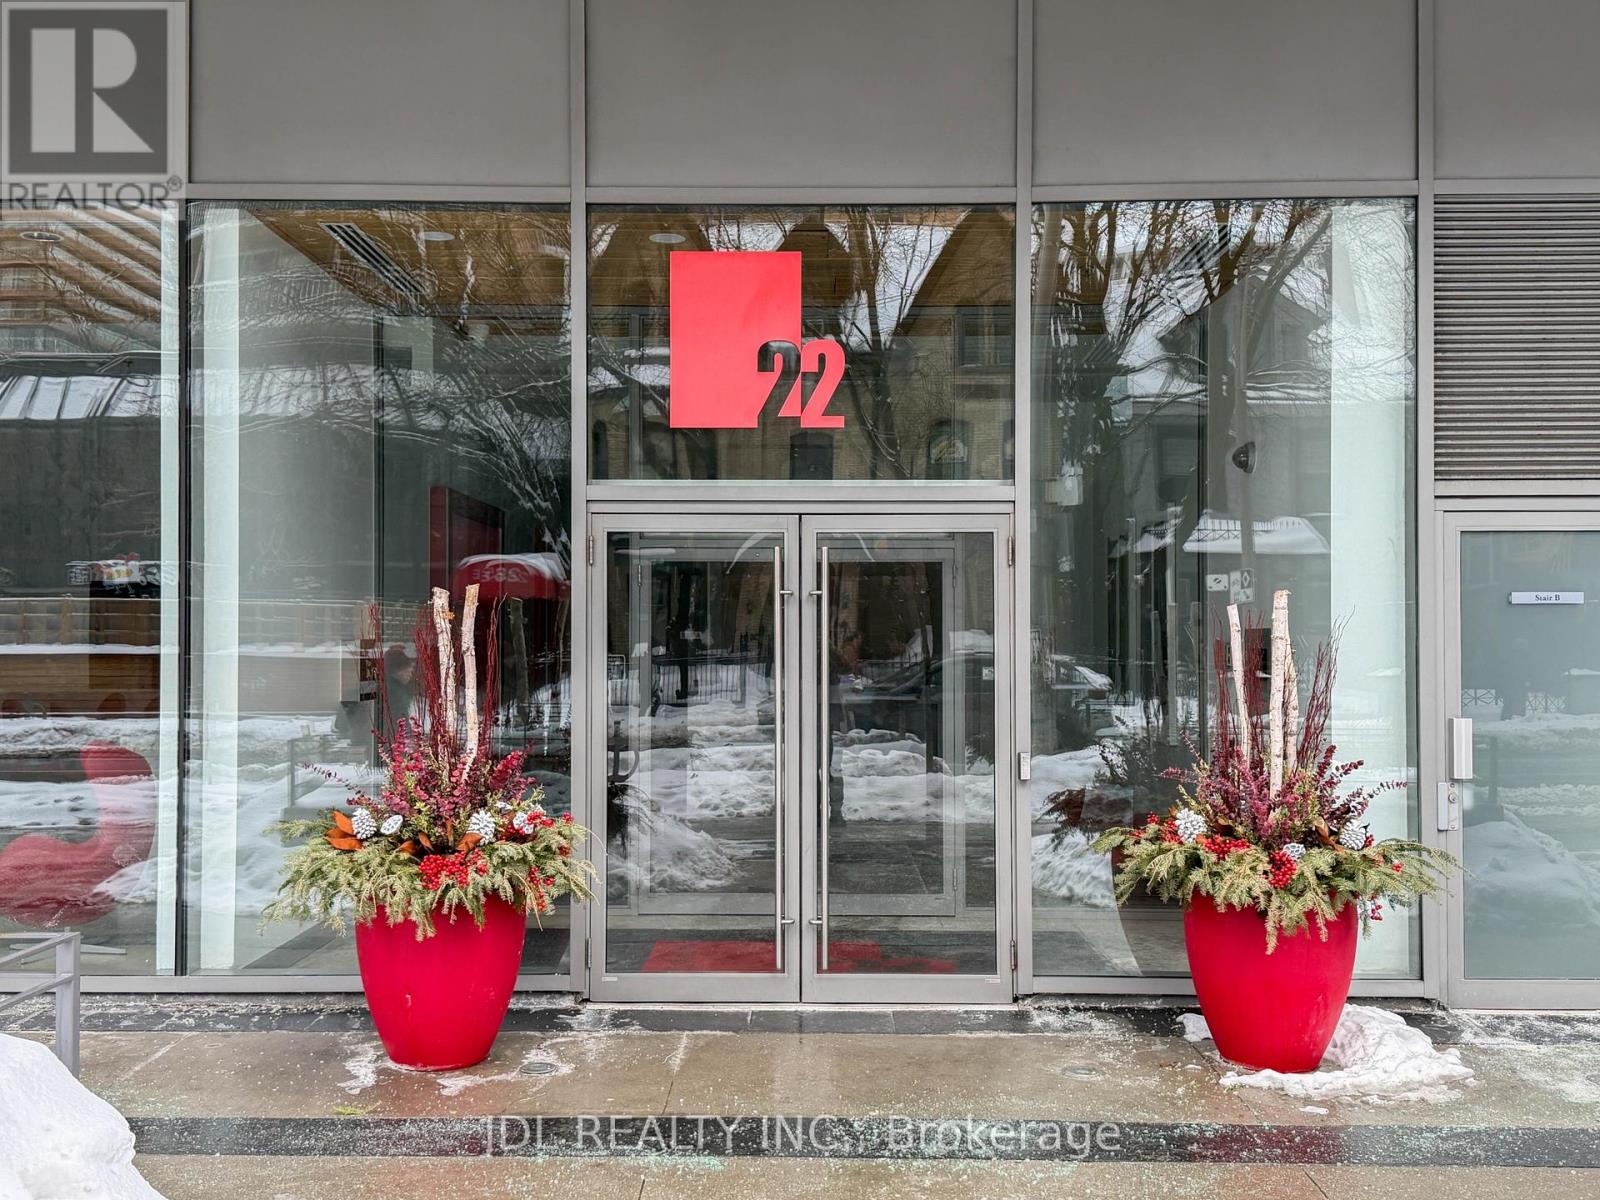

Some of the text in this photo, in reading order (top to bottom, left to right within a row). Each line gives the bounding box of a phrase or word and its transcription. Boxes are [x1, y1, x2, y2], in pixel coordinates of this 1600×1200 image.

[757, 339, 846, 428] 22
[1534, 594, 1561, 602] Stair B
